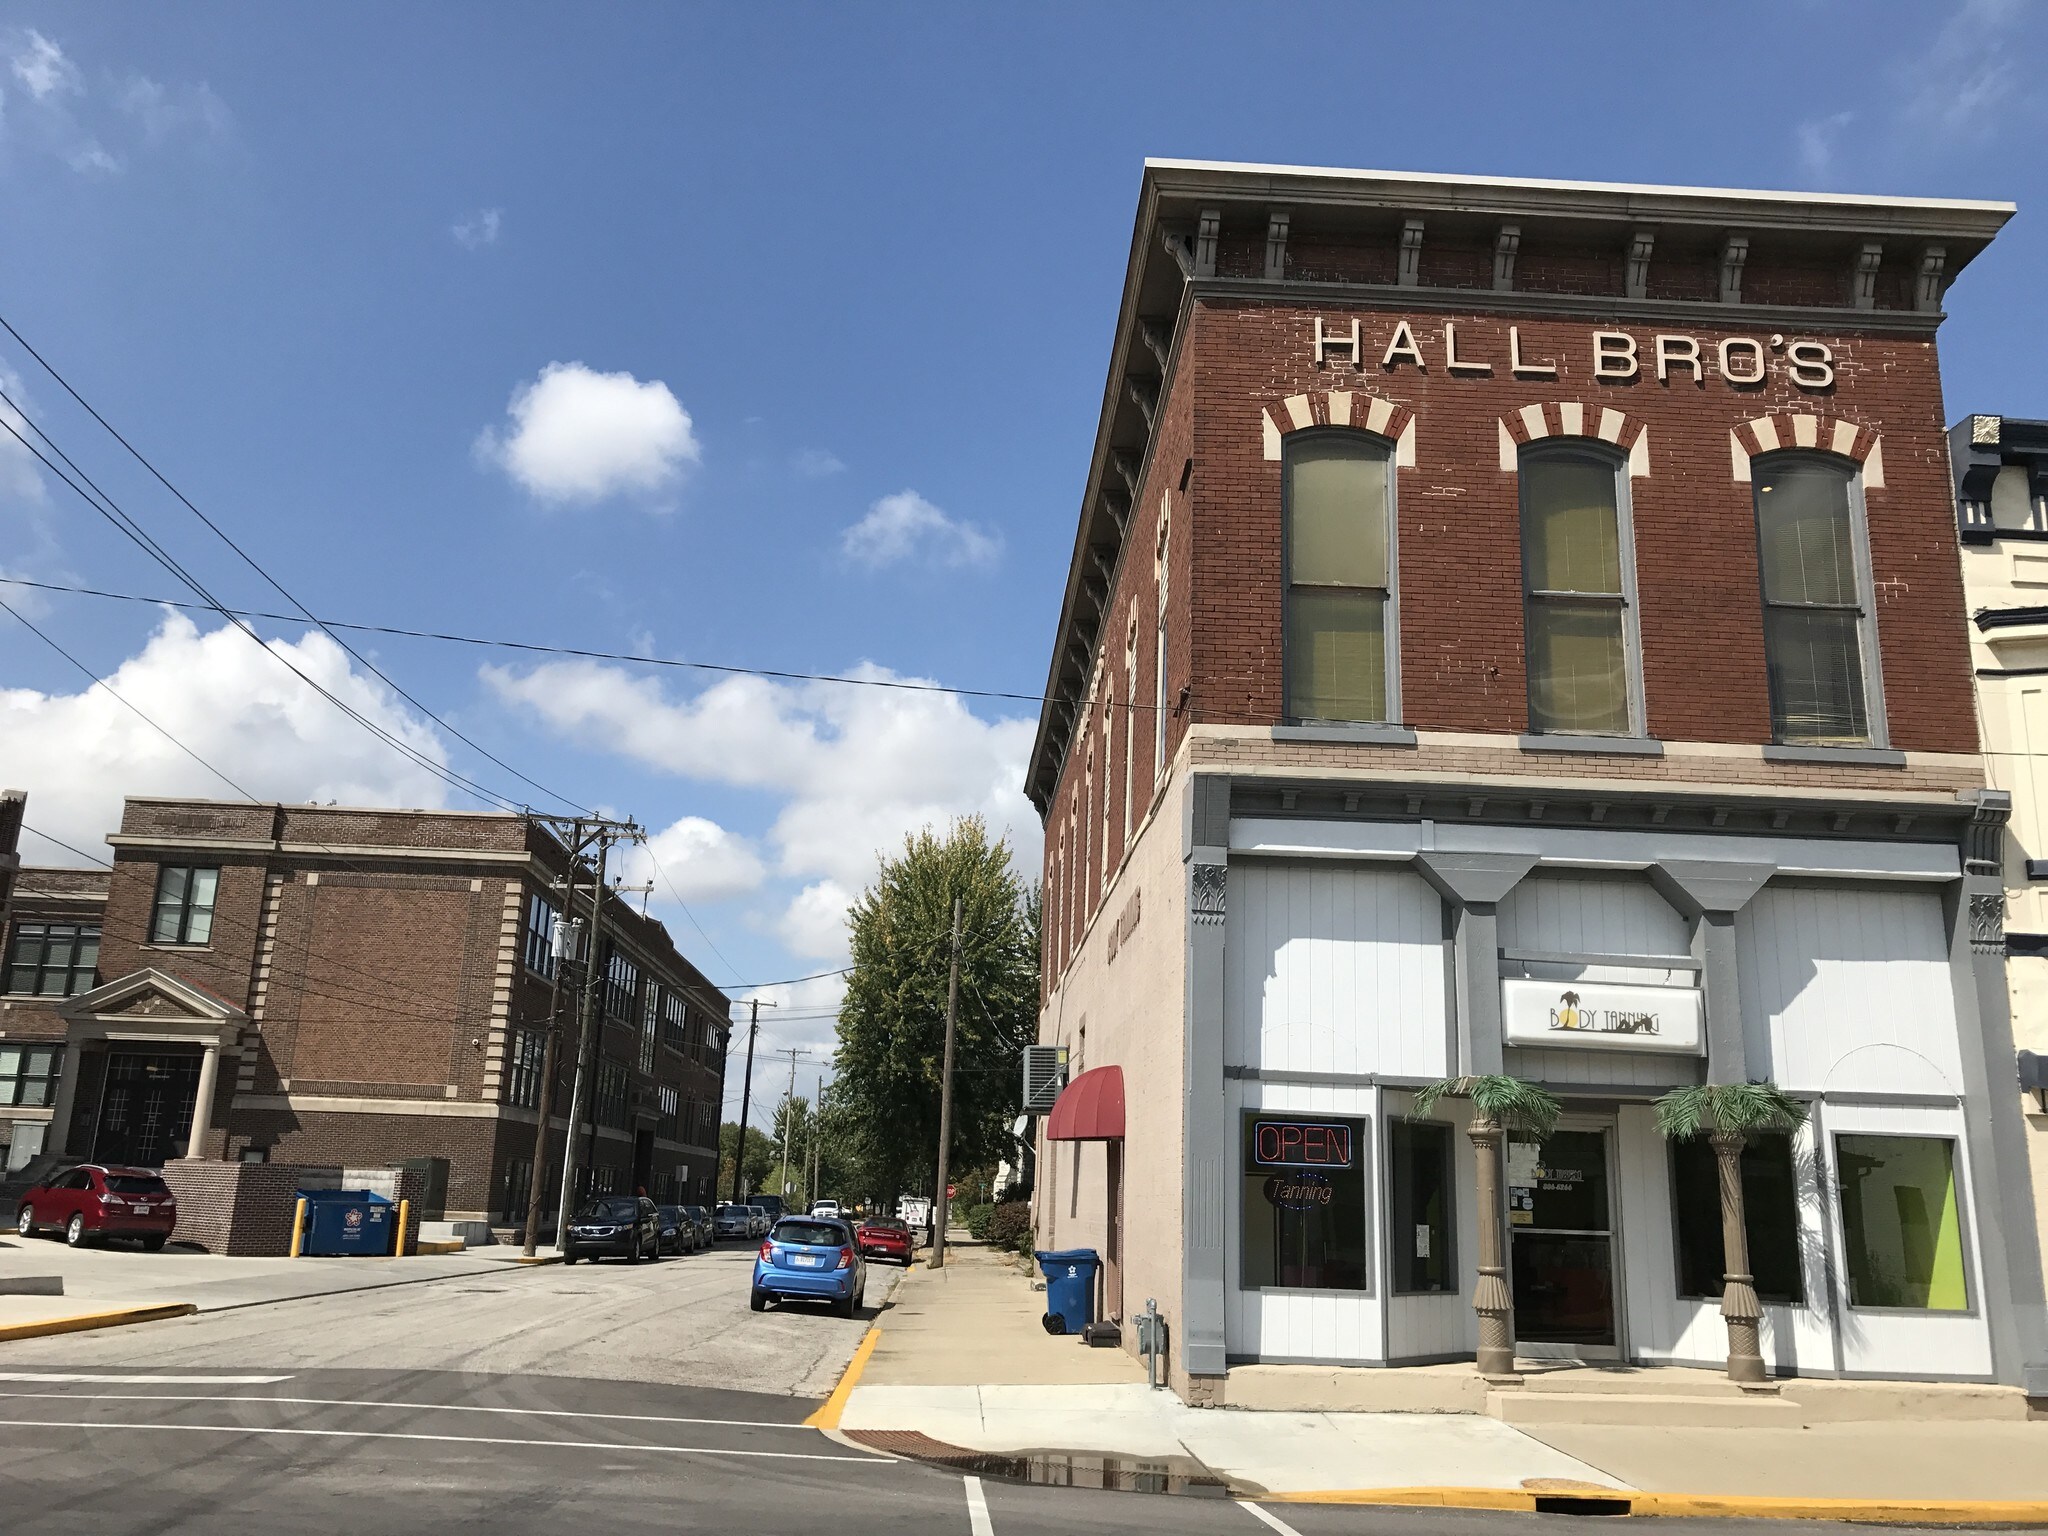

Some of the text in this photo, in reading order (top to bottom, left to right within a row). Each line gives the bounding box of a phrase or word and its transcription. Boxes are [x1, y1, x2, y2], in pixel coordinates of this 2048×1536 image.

[1314, 316, 1835, 388] HALL BRO'S
[1259, 1126, 1348, 1164] OPEN
[1272, 1179, 1333, 1205] Tanning
